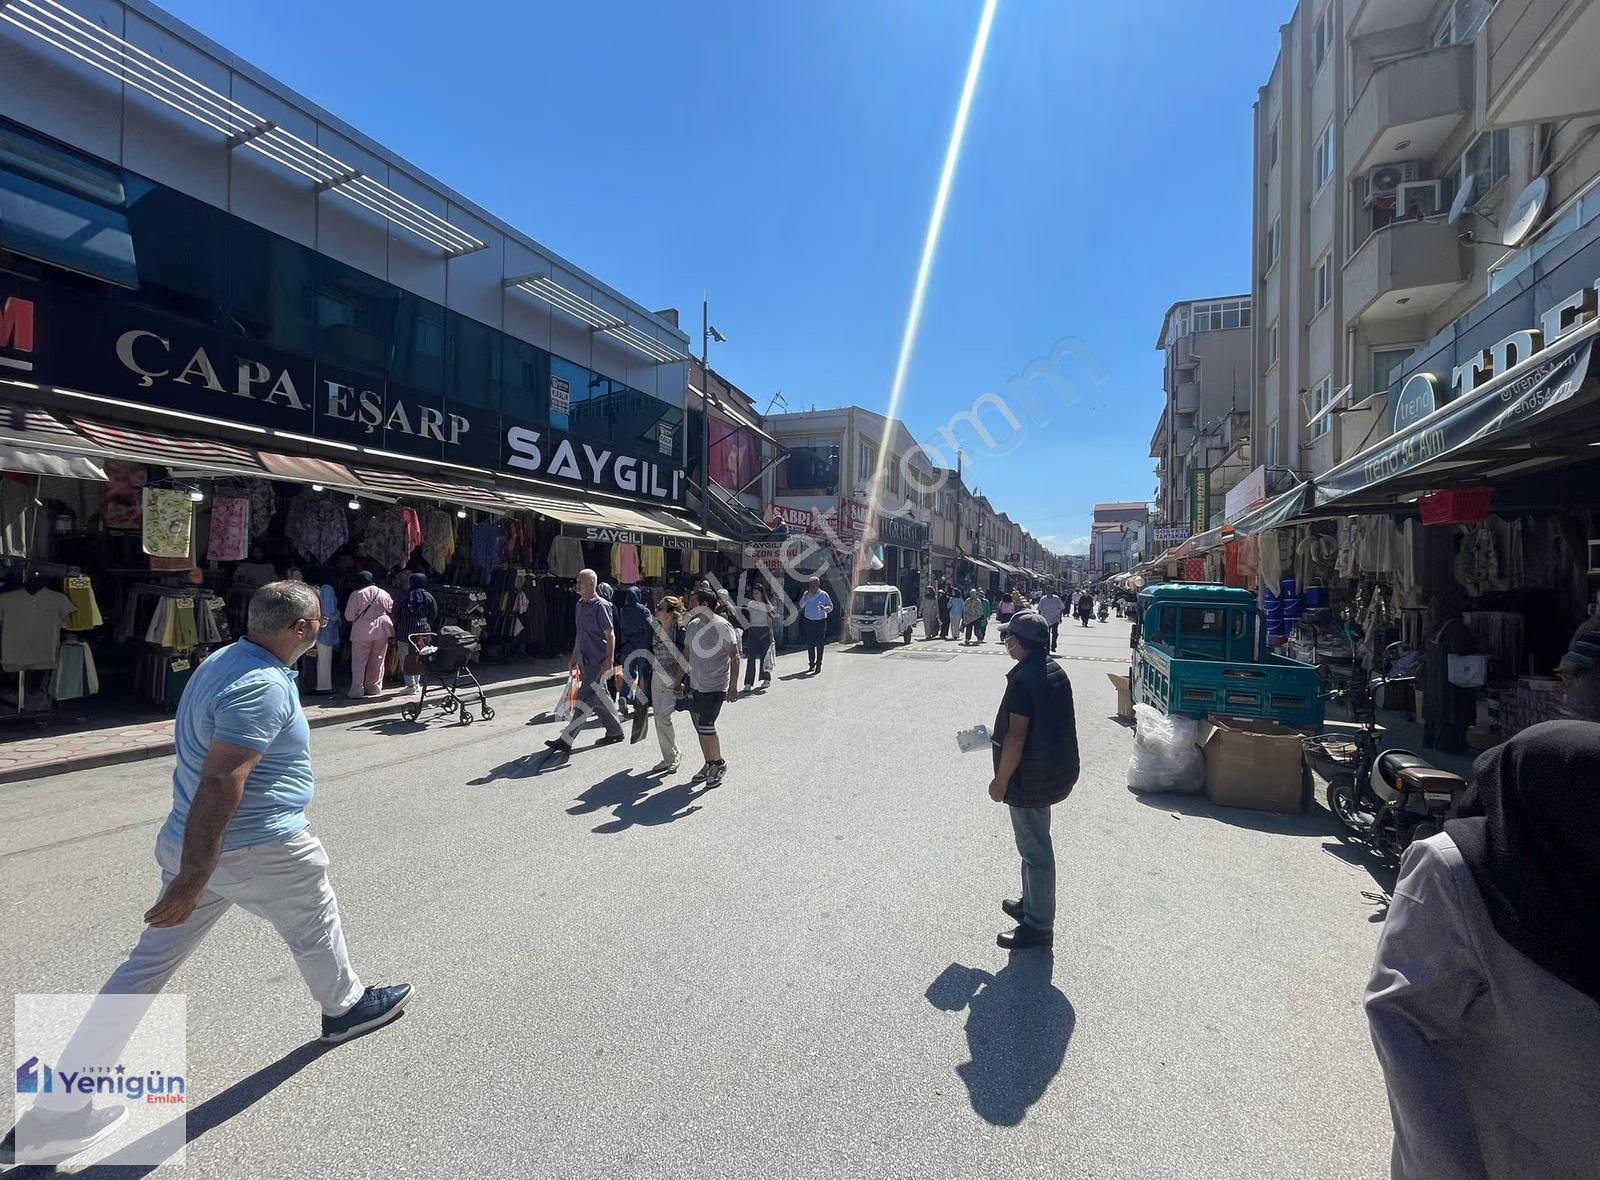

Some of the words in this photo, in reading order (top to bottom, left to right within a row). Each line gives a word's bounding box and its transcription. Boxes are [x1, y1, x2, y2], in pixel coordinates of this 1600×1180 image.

[116, 330, 309, 410] ÇAPA
[323, 379, 470, 445] EŞARP
[1364, 446, 1399, 482] trend
[1400, 439, 1415, 465] 54
[1419, 429, 1446, 457] Avm
[586, 528, 644, 544] SAYGILI
[658, 535, 694, 549] Tekstil
